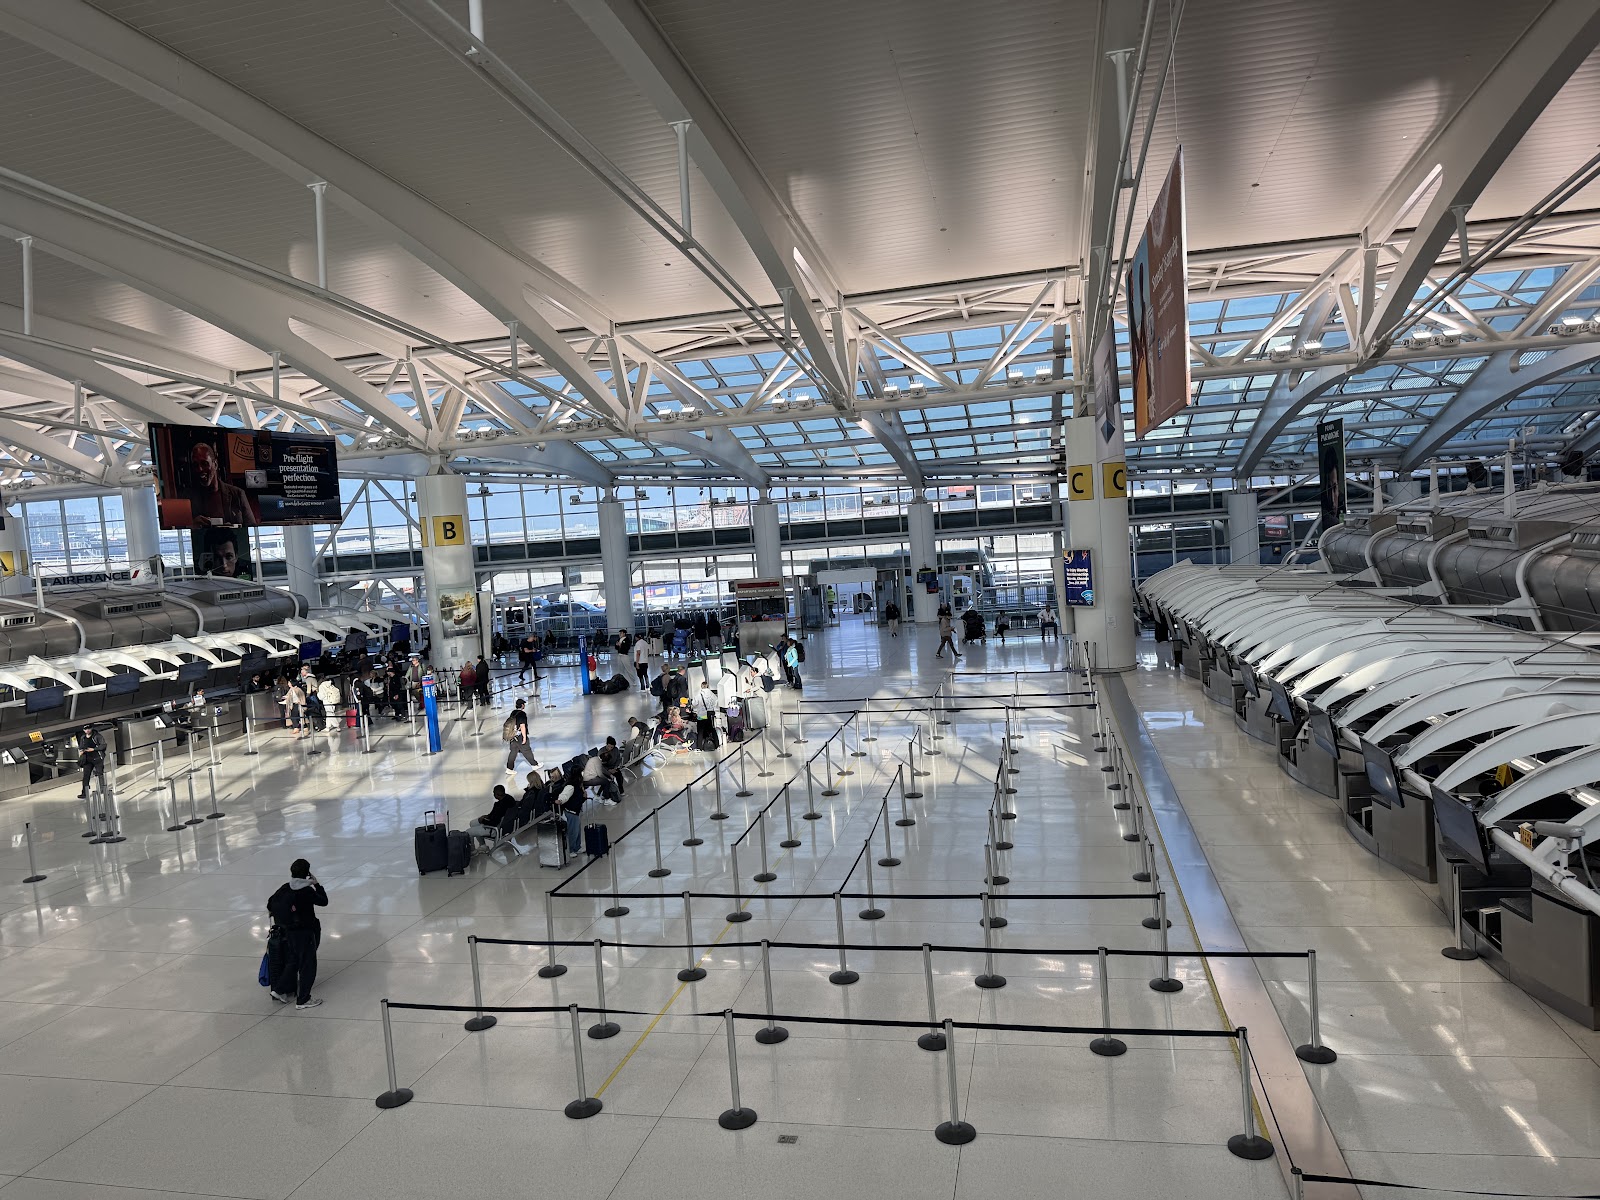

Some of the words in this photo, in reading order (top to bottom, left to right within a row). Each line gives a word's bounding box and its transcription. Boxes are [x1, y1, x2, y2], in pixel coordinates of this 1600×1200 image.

[283, 454, 313, 464] Pre-flight
[279, 465, 319, 473] presentation
[283, 473, 317, 483] perfection.
[1072, 473, 1084, 493] C
[1113, 469, 1124, 490] C
[443, 522, 456, 539] B
[53, 571, 131, 586] AIRFRANCE
